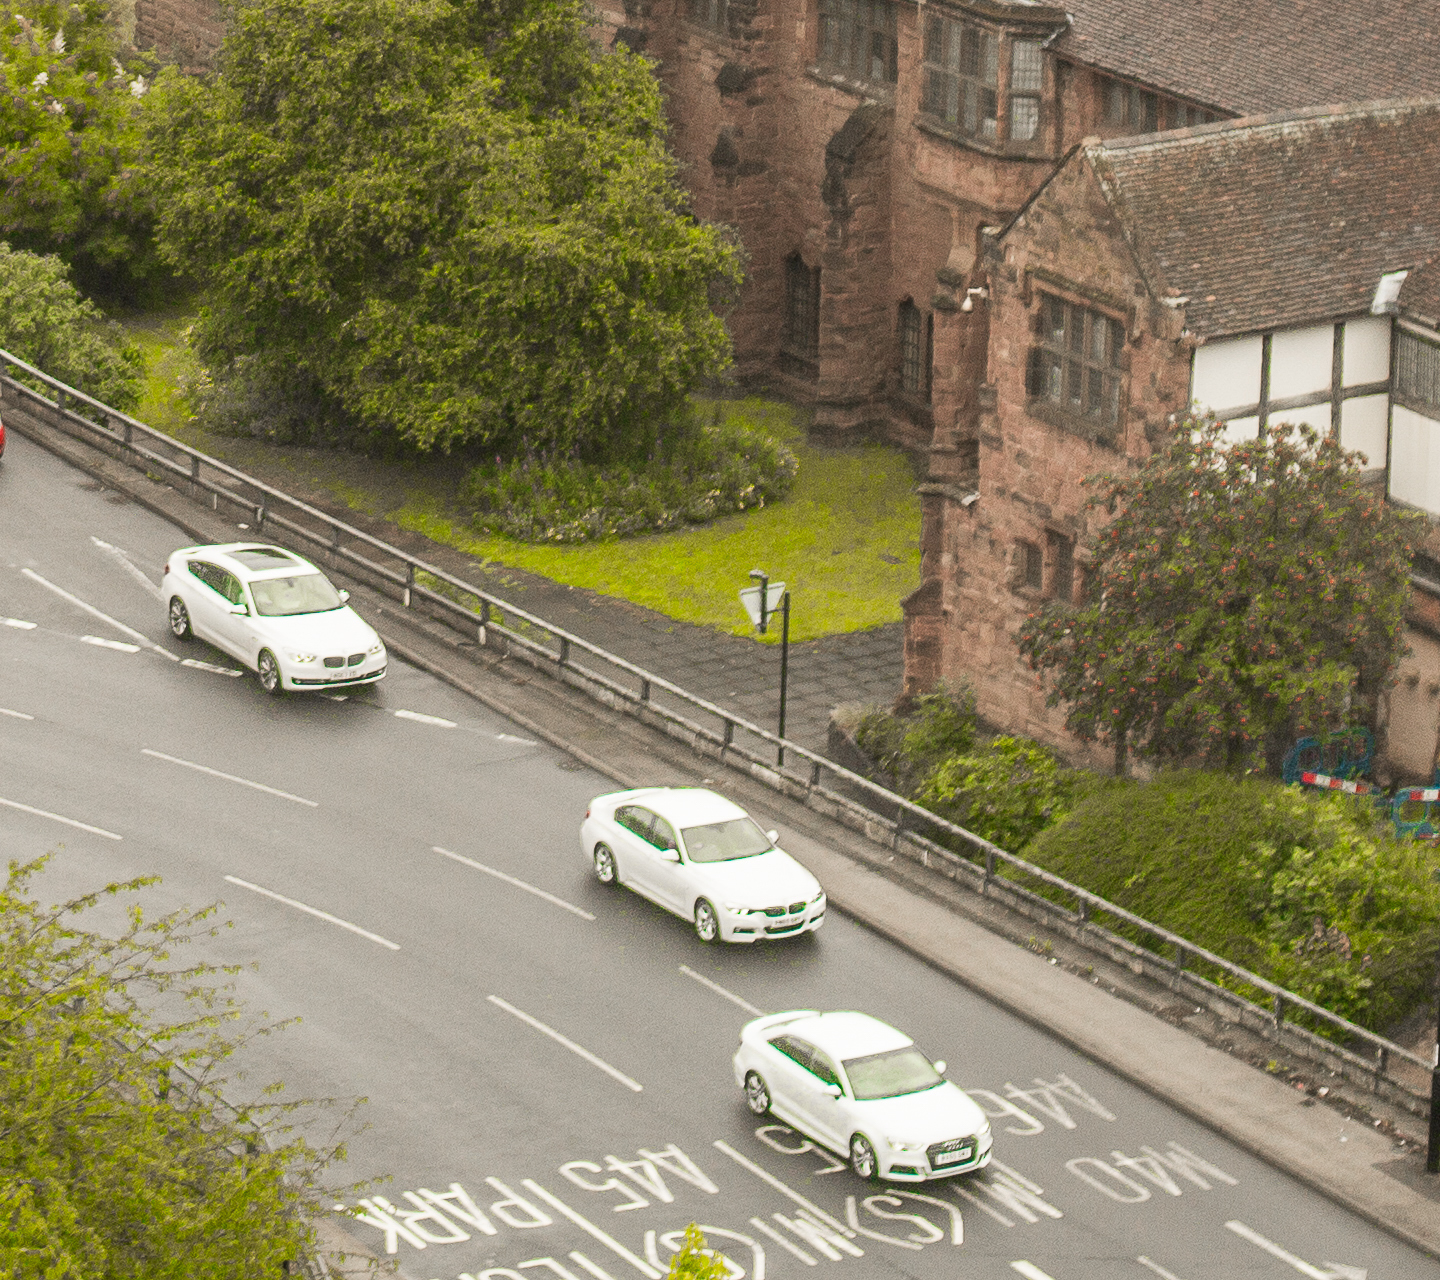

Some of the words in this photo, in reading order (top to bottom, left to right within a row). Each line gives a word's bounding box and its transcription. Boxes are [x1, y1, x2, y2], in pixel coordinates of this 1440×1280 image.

[966, 1073, 1116, 1136] A46
[560, 1143, 719, 1213] A45
[1066, 1140, 1239, 1204] M40
